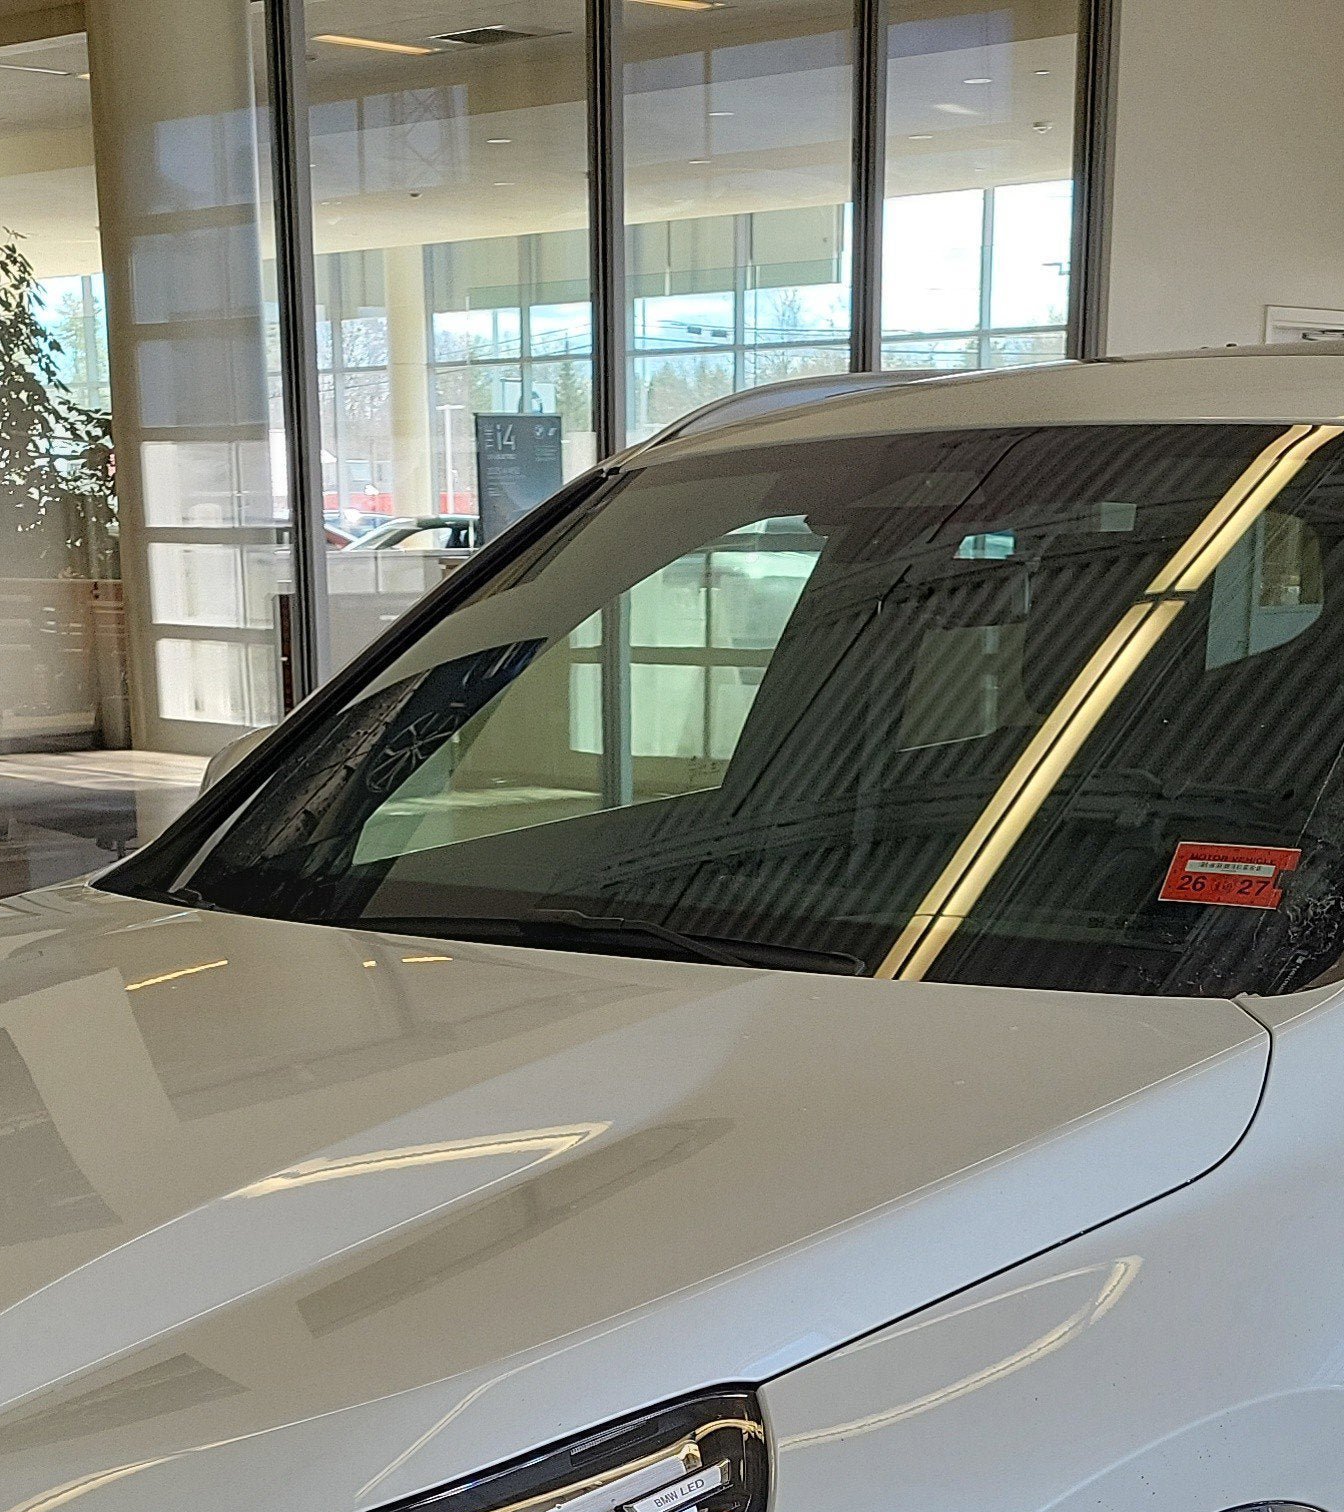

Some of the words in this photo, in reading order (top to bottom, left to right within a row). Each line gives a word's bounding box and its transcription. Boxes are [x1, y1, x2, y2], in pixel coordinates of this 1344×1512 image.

[495, 423, 517, 451] i4
[1189, 853, 1229, 862] MOTOR
[1176, 874, 1208, 892] 26
[1237, 878, 1271, 897] 27
[653, 1490, 680, 1509] BMW
[679, 1478, 706, 1496] LED
